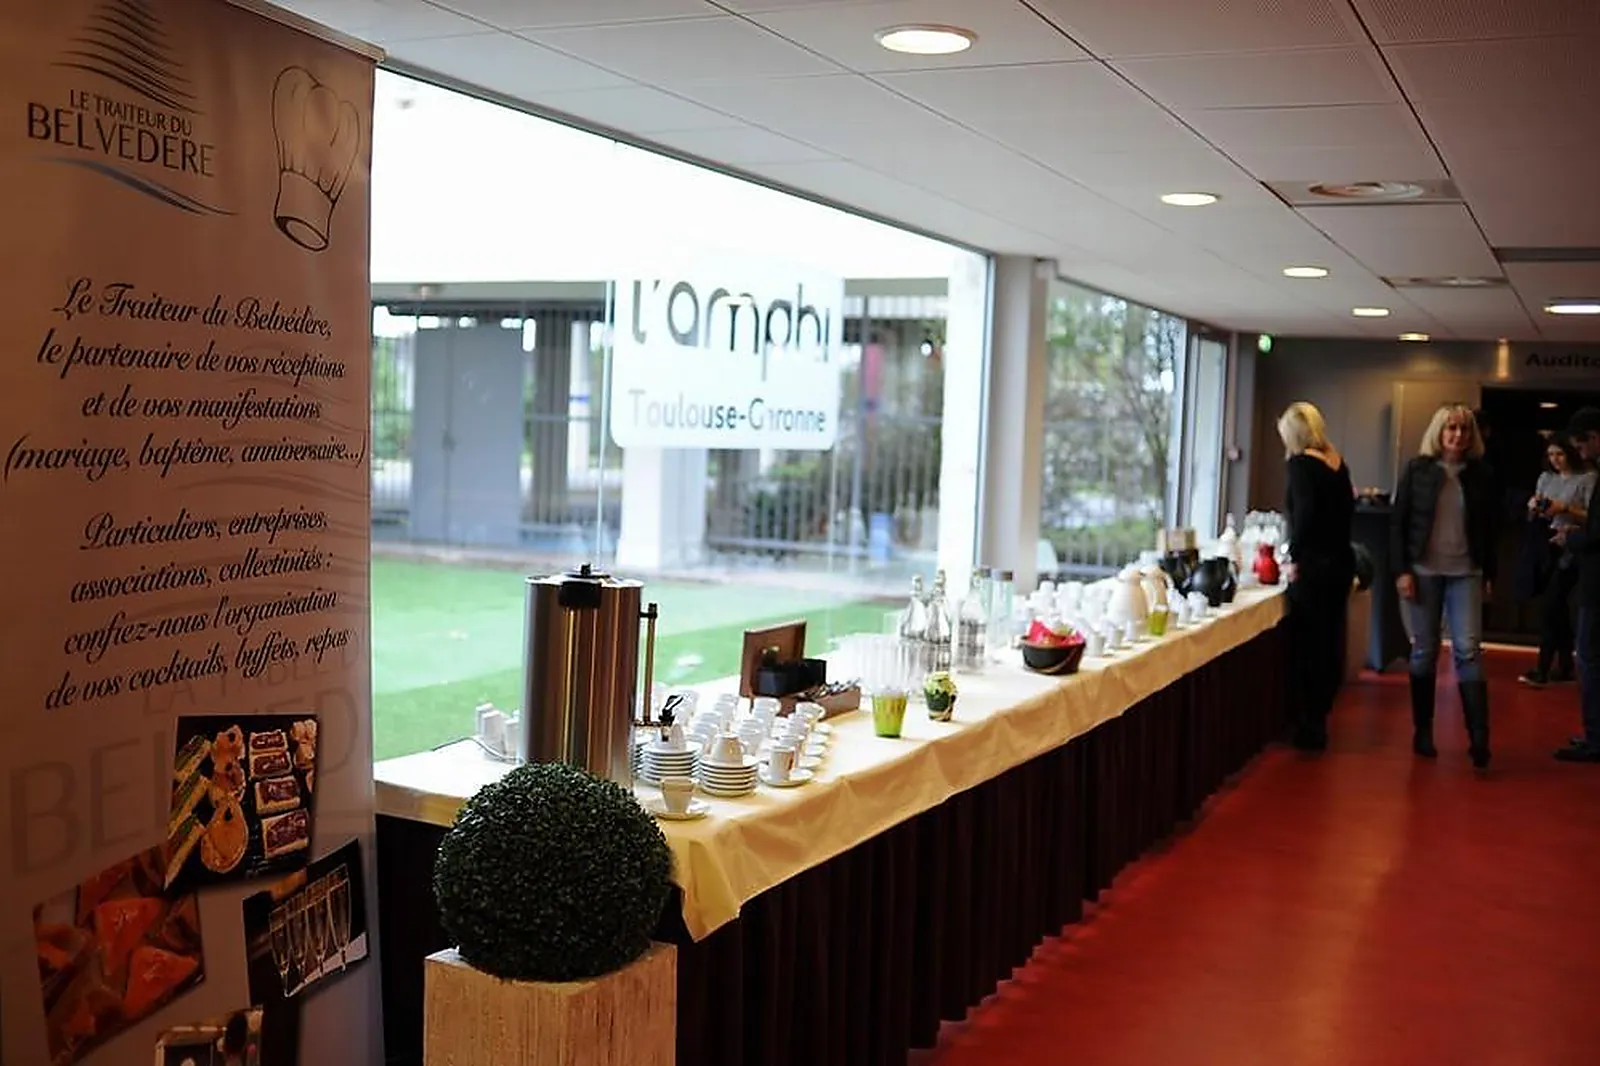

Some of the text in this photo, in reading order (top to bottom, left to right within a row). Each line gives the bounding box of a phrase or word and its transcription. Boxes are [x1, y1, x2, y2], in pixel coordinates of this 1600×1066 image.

[70, 89, 193, 137] LE TRAITEUR DU
[28, 101, 215, 177] BELVEDERE
[51, 277, 332, 338] Le Traiteur du Belvédère,
[37, 328, 345, 388] le partenaire de vos réceptions
[81, 383, 323, 431] et de vos manifestations
[627, 388, 827, 433] Toulouse-Gronne
[3, 433, 131, 482] (mariage,
[139, 433, 235, 478] baptême,
[80, 507, 222, 550] Particuliers,
[70, 562, 213, 604] associations,
[64, 586, 337, 664] confiez-nous l'organisation
[45, 627, 350, 711] de vos cocktails, buffets, repas
